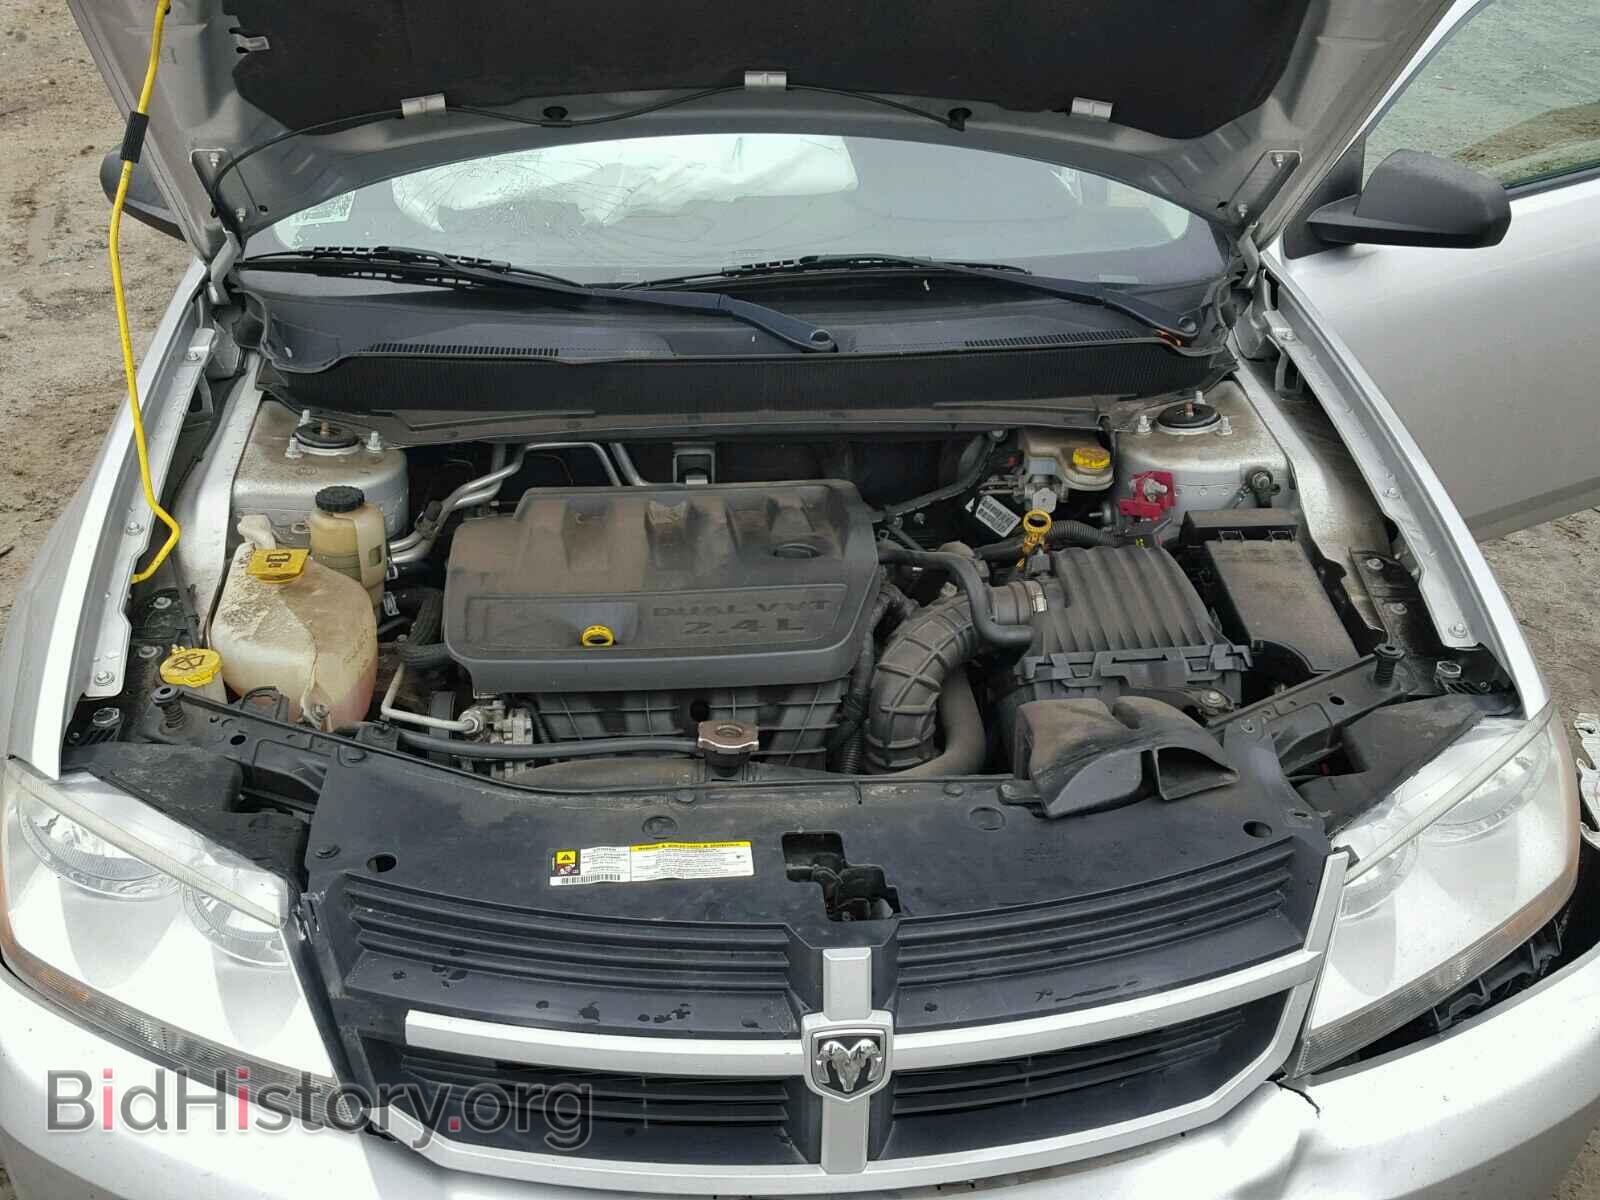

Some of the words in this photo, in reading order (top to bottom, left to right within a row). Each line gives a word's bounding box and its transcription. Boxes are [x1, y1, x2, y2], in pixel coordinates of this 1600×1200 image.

[652, 604, 745, 617] DUAL
[756, 600, 833, 613] VVT
[682, 617, 805, 635] 2.4L
